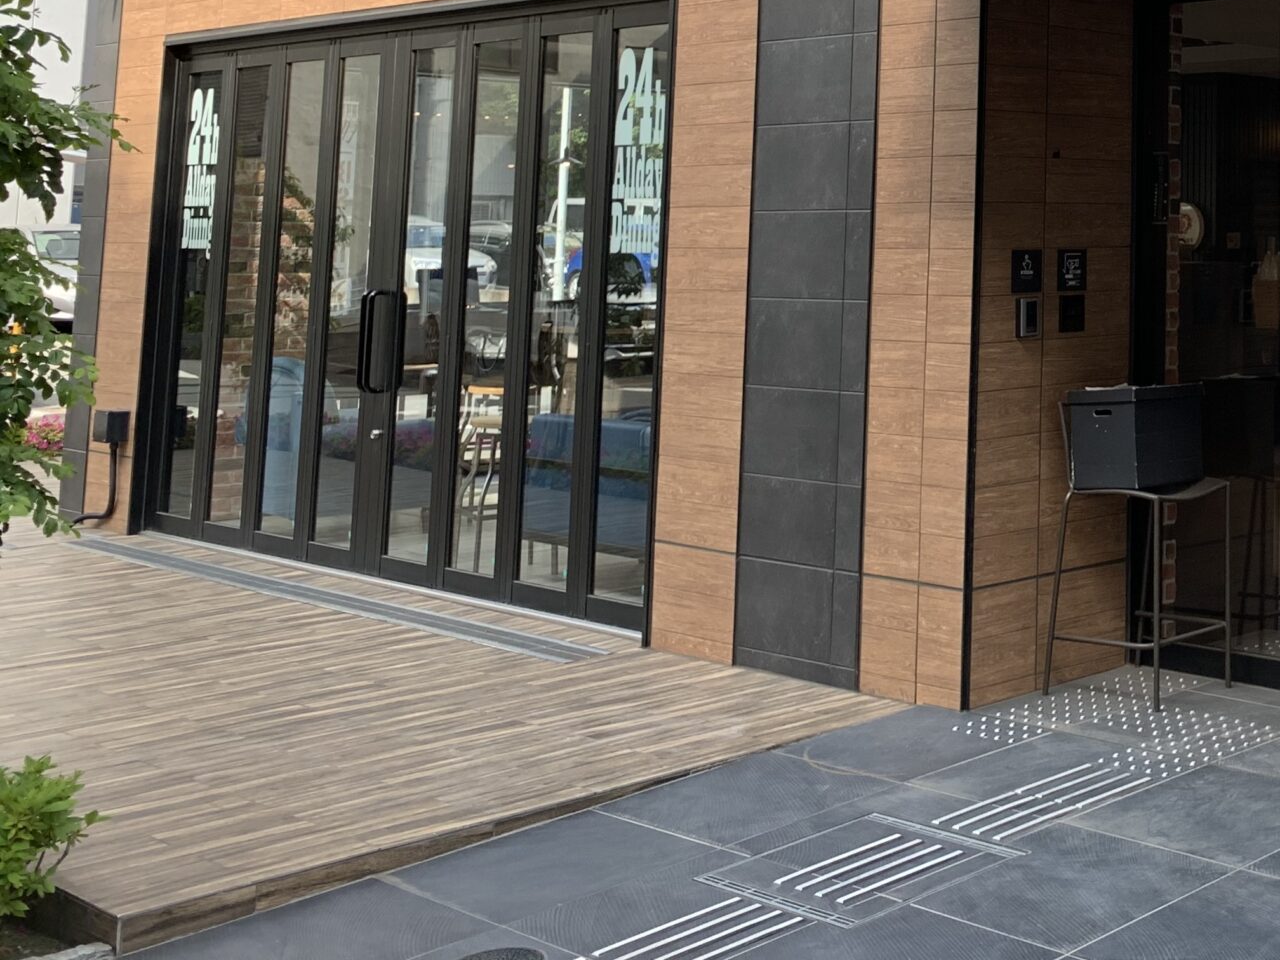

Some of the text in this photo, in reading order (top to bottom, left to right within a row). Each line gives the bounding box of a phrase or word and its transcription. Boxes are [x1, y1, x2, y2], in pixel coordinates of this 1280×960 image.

[187, 88, 220, 165] 24h
[614, 47, 666, 146] 24h
[184, 166, 216, 217] Allday
[612, 146, 664, 211] Allday
[181, 207, 213, 260] Dining
[609, 200, 661, 269] Dining
